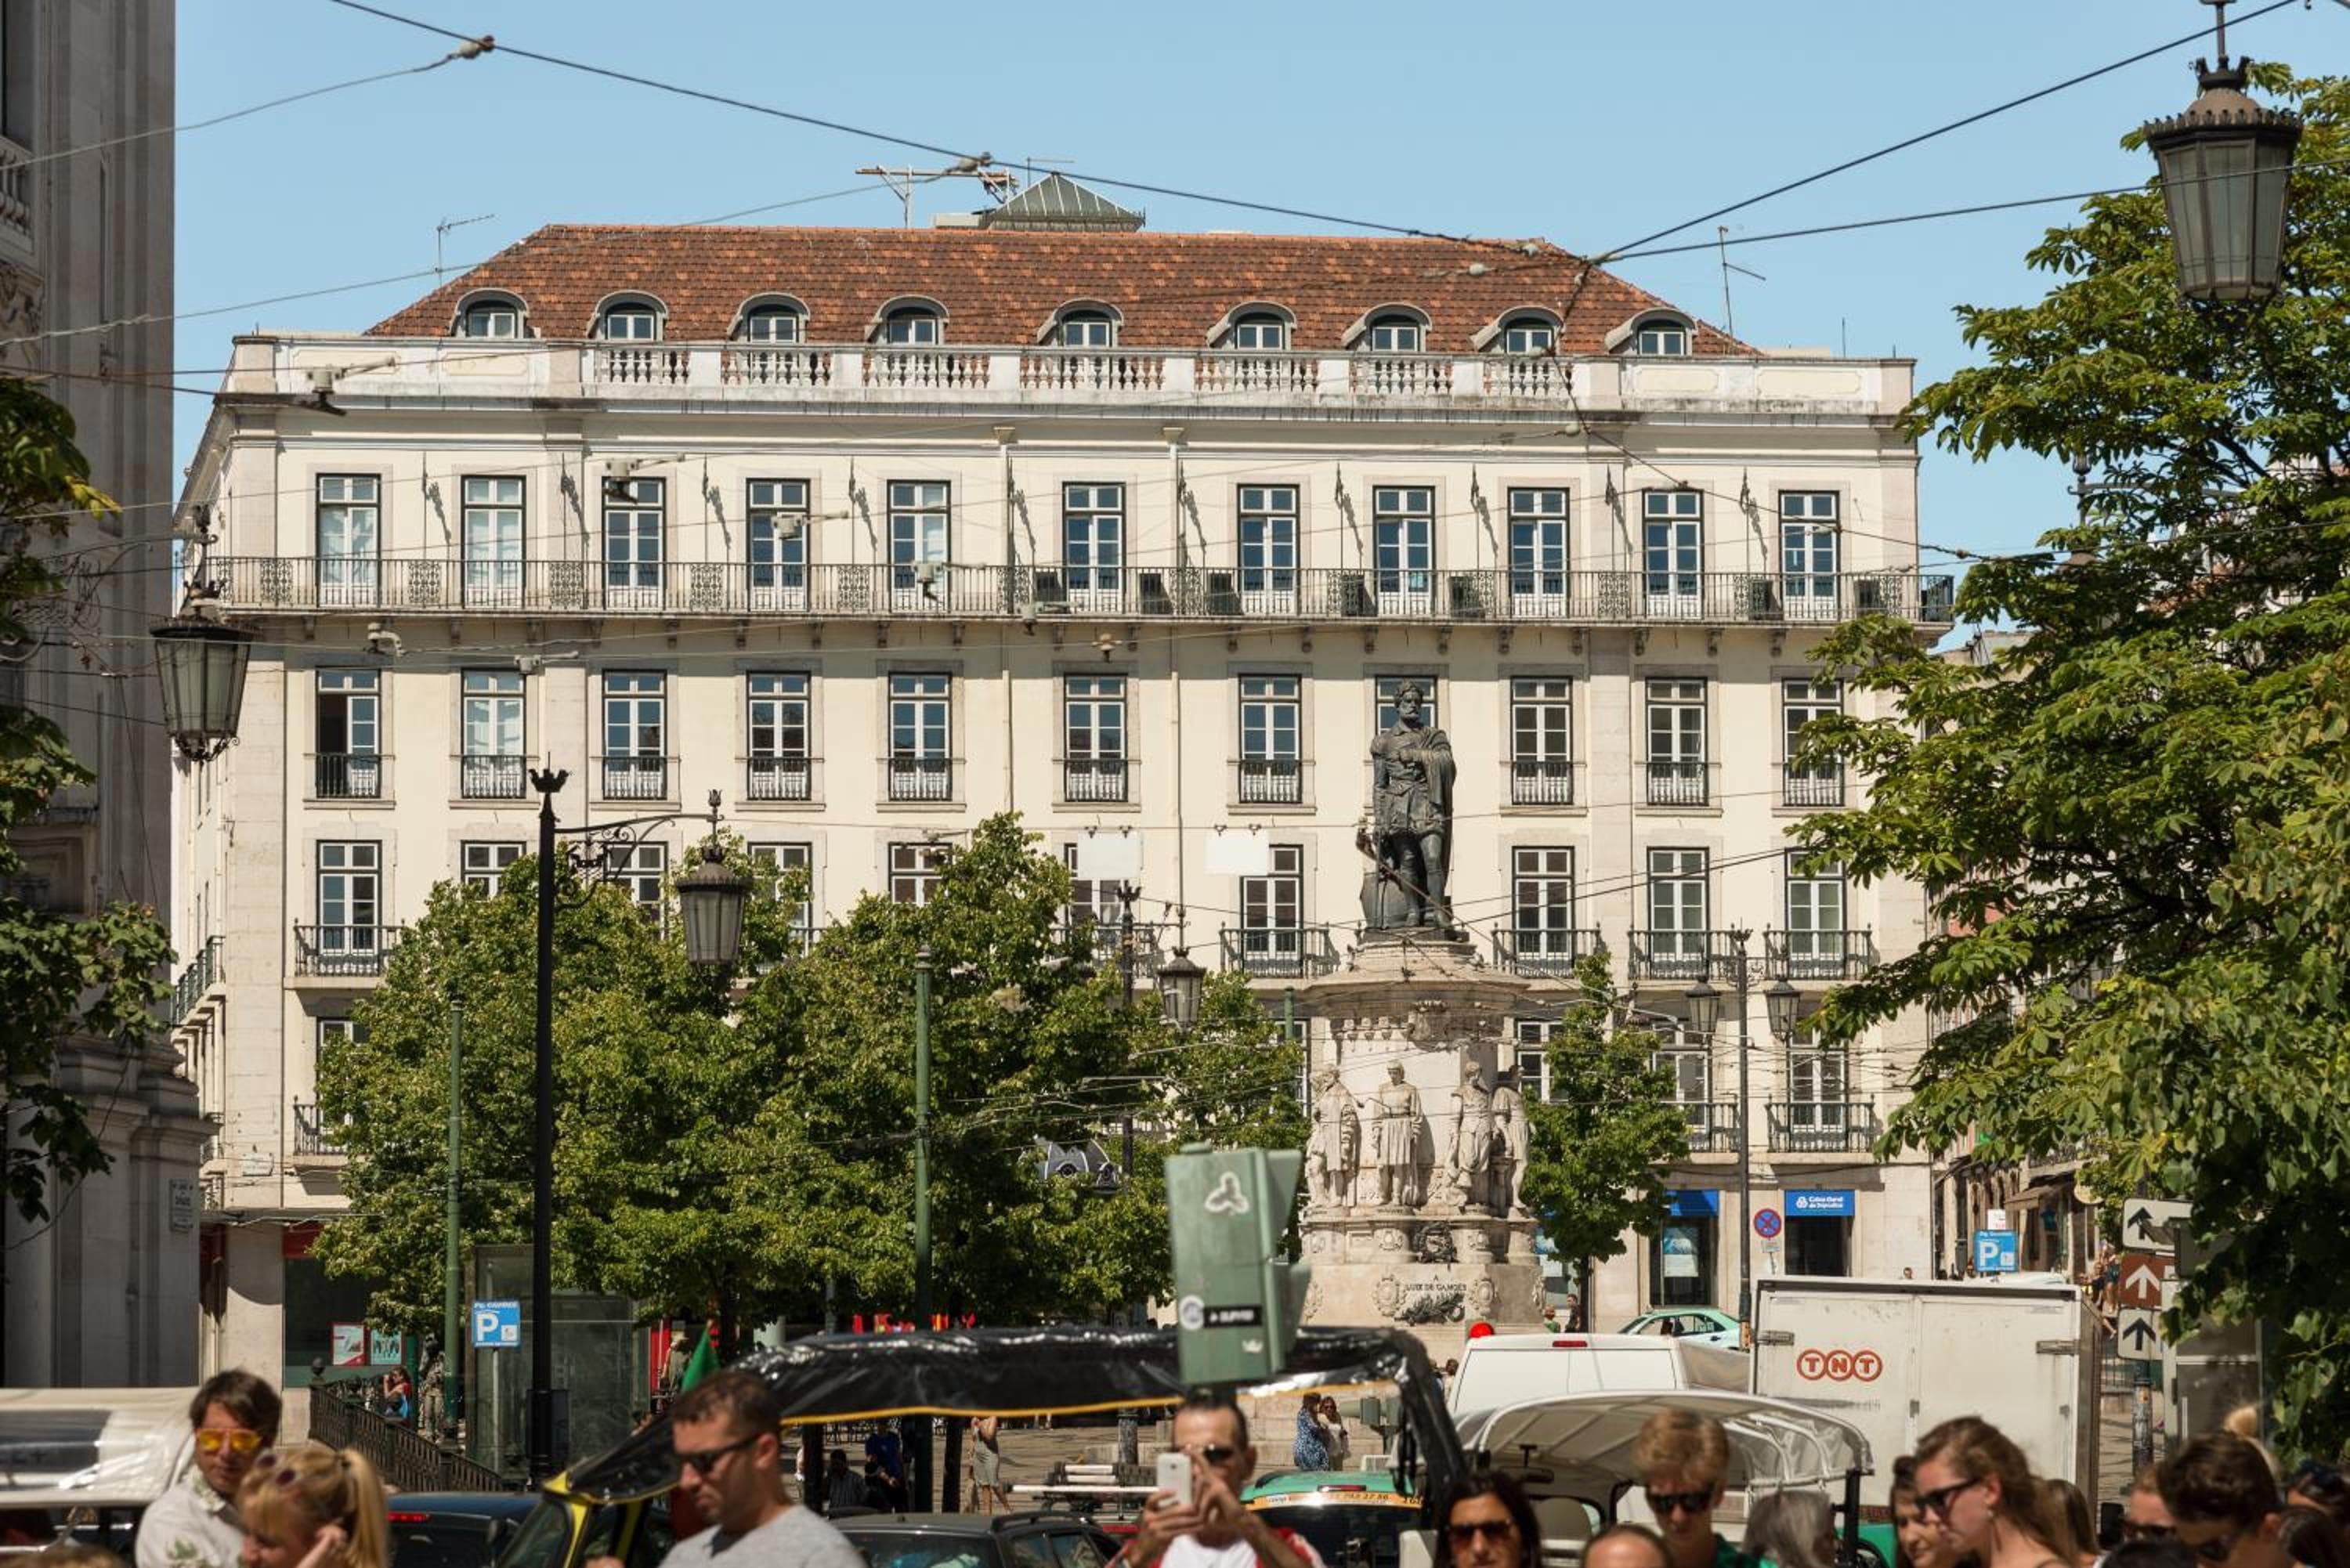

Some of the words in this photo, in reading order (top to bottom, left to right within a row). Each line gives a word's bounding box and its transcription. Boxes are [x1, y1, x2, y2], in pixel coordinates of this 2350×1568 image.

[1979, 1242, 1998, 1266] P
[476, 1313, 499, 1342] P
[1798, 1350, 1882, 1380] TNT
